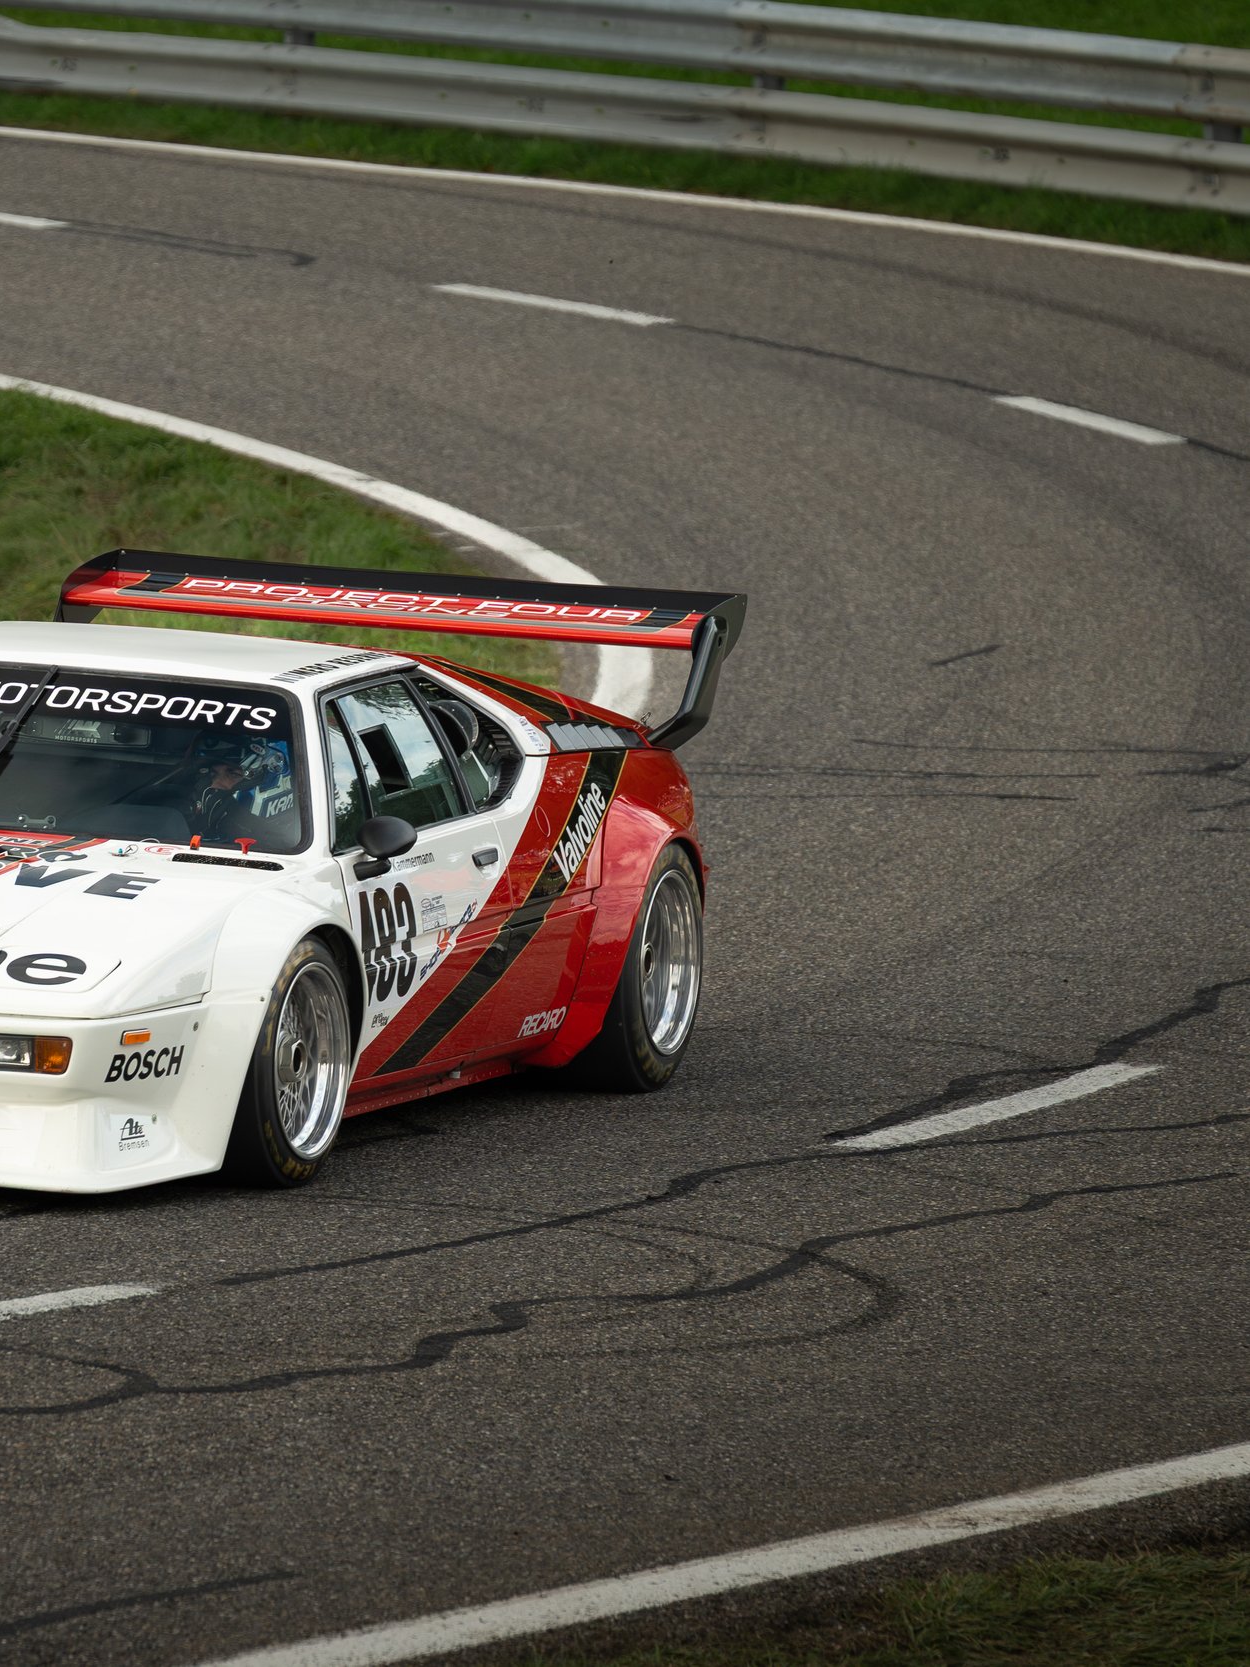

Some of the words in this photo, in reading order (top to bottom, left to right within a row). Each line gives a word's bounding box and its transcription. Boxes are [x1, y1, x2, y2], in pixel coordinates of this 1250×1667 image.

[183, 579, 460, 607] PROJECT
[475, 600, 642, 621] FOUR
[54, 735, 98, 744] MOTORSPORTS
[553, 782, 606, 883] Valvoline
[516, 1005, 567, 1038] RECARO
[104, 1045, 185, 1083] BOSCH
[118, 1139, 149, 1151] Bremsen
